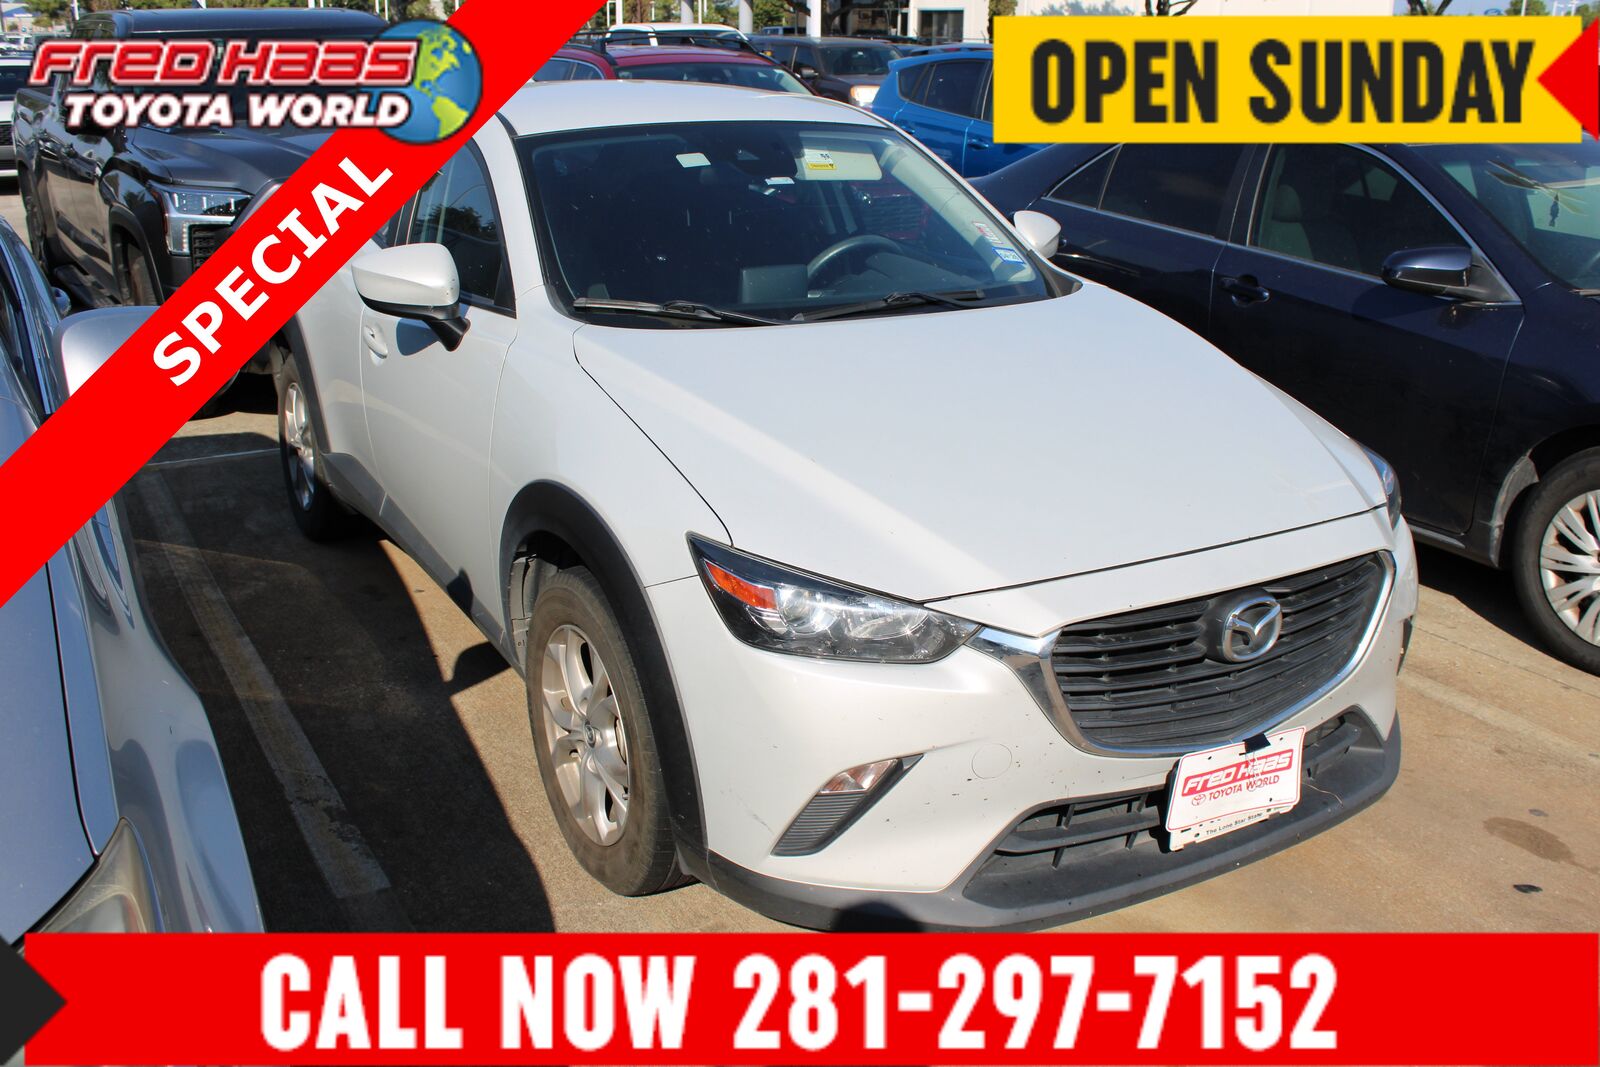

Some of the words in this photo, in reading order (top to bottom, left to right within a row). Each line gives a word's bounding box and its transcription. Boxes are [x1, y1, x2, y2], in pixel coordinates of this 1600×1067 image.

[1208, 785, 1243, 801] TOYOTA
[1246, 774, 1280, 791] WORLD
[1206, 827, 1217, 836] The
[1218, 822, 1233, 832] Lone
[1234, 817, 1247, 826] Star
